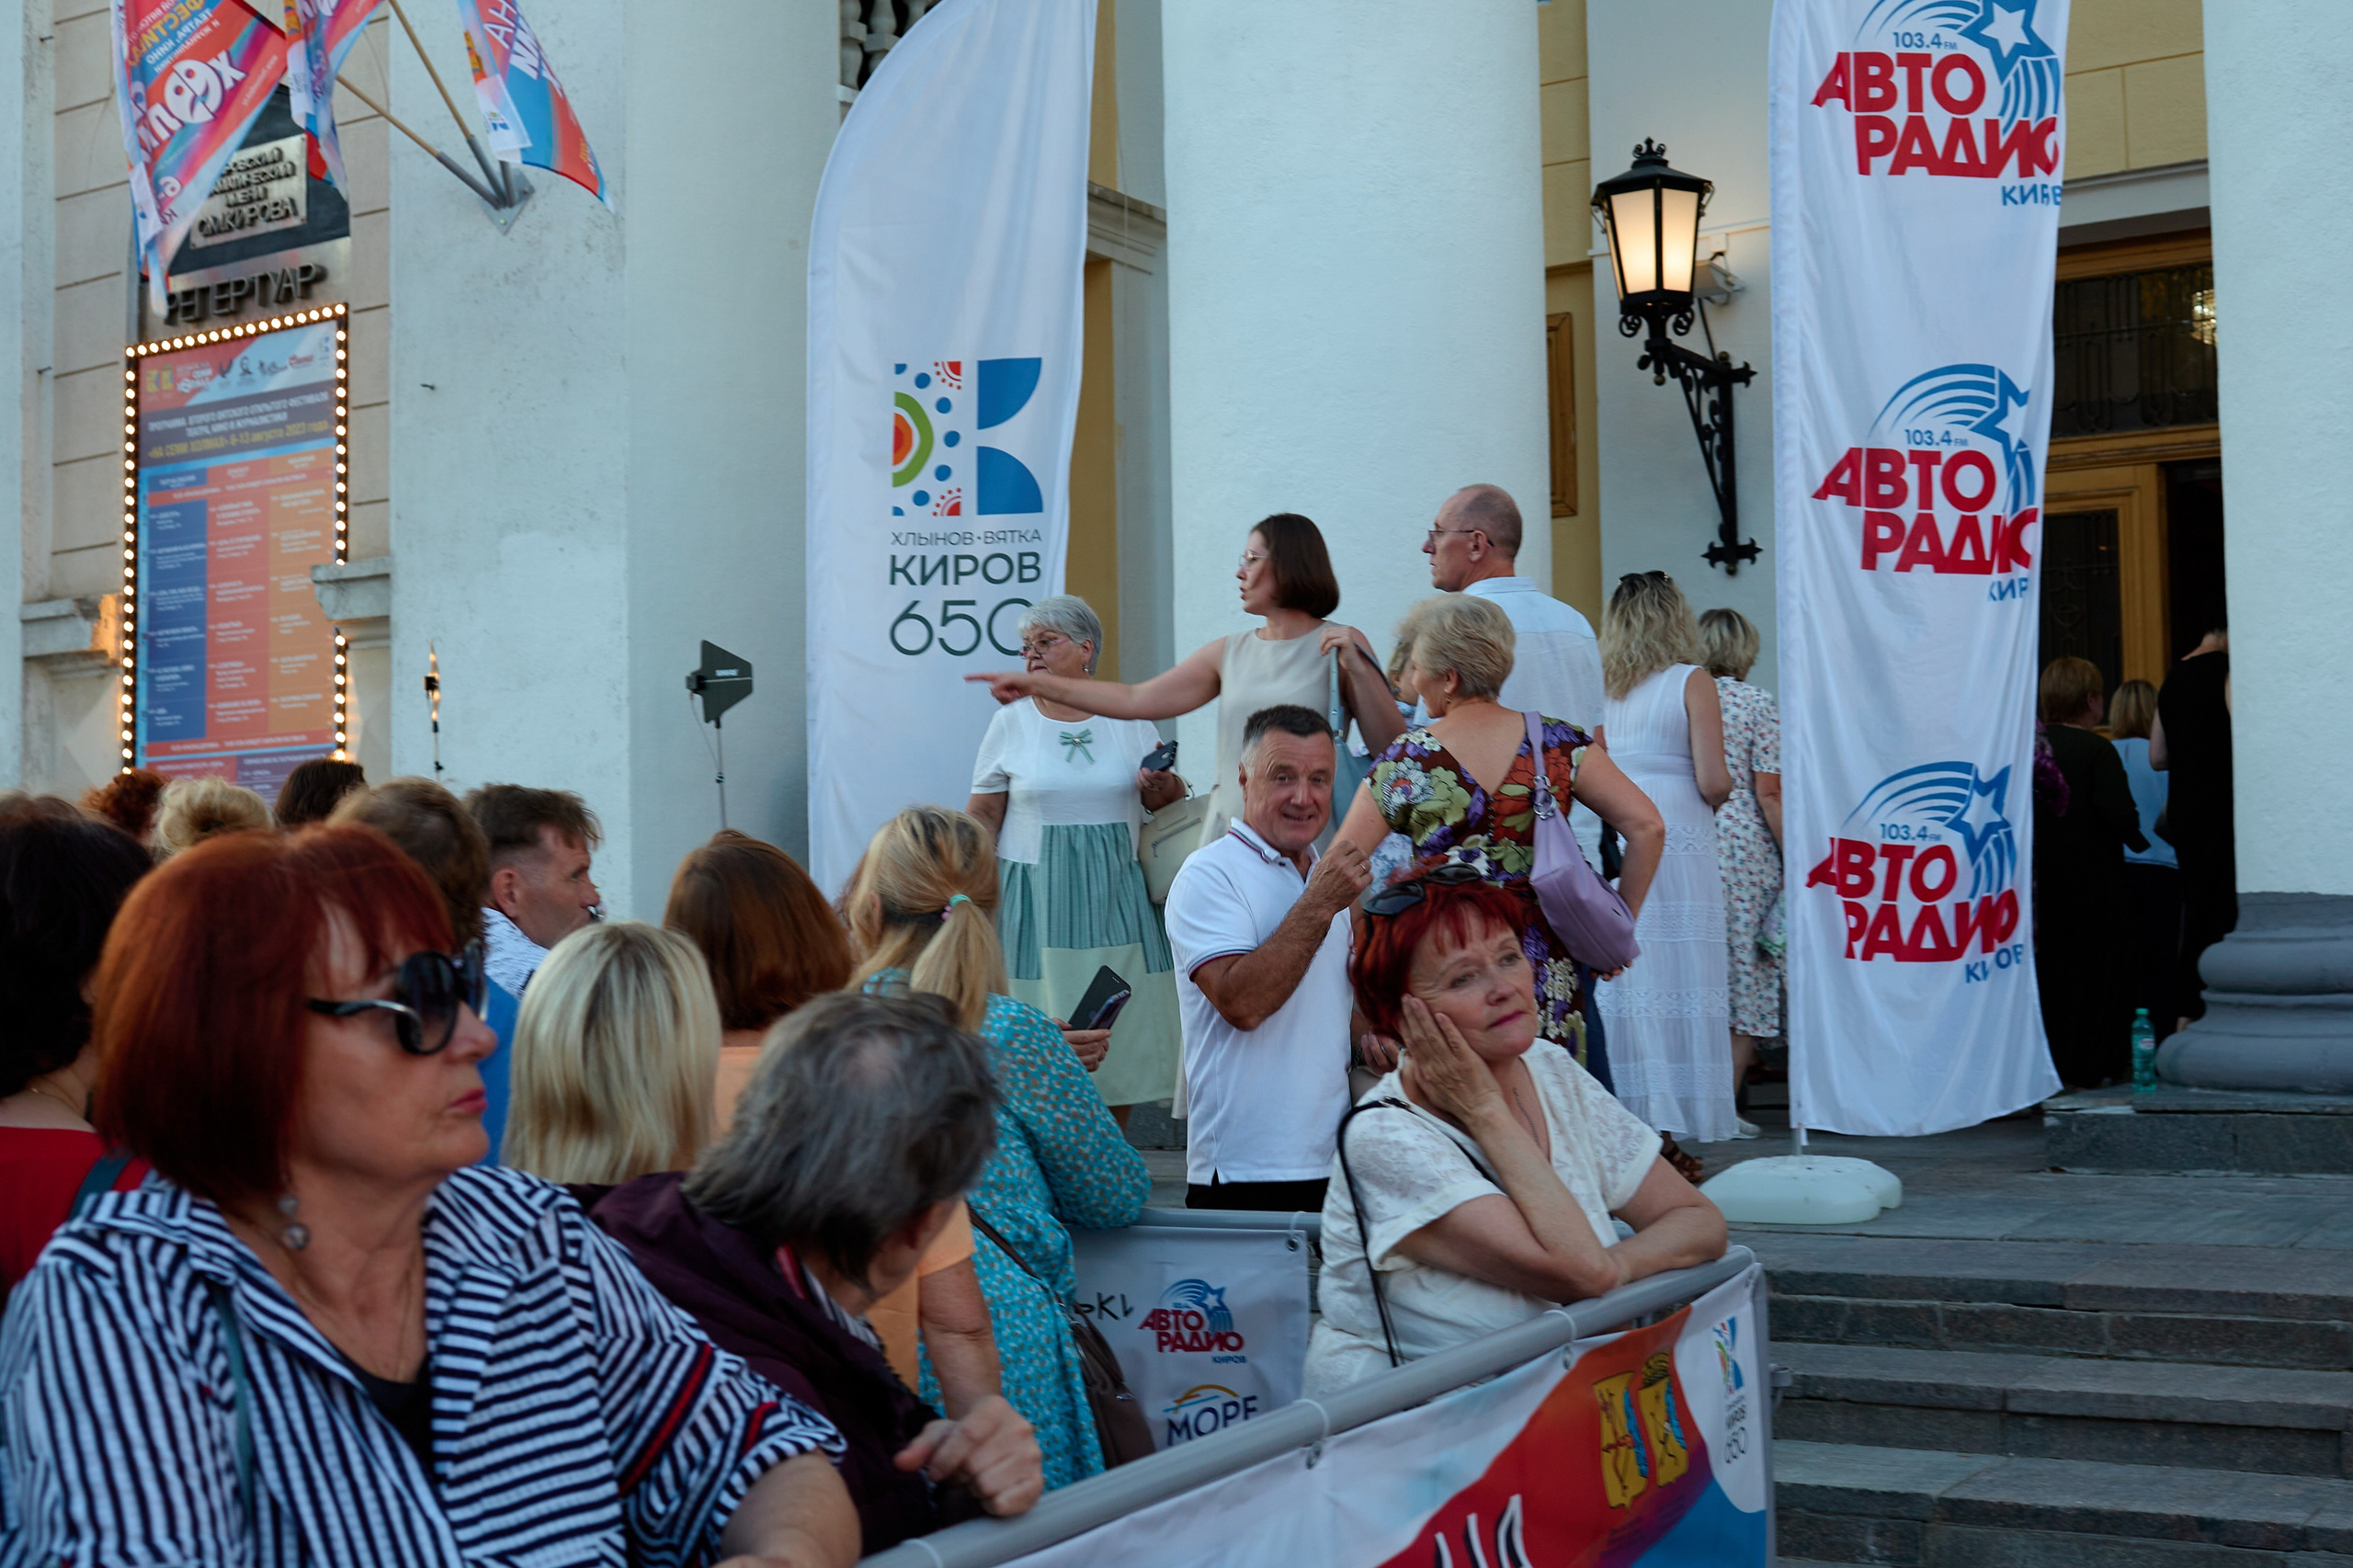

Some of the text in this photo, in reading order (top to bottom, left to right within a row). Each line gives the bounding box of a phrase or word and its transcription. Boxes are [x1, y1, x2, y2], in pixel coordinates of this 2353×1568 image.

[1893, 31, 1942, 49] 103.4
[1810, 51, 1986, 116] АВТО
[1855, 115, 2059, 179] РАДИО
[165, 262, 322, 324] РЕПЕРТУАР
[1904, 429, 1952, 446] 103.4
[1811, 447, 1996, 512] АВТО
[889, 551, 1041, 585] КИРОВ
[890, 597, 1033, 656] 650
[1880, 824, 1927, 841] 103.4
[1805, 836, 1958, 903] АВТО
[1843, 889, 2019, 962] РАДИО
[1138, 1308, 1205, 1332] АВТО
[1156, 1330, 1245, 1353] РАДИО
